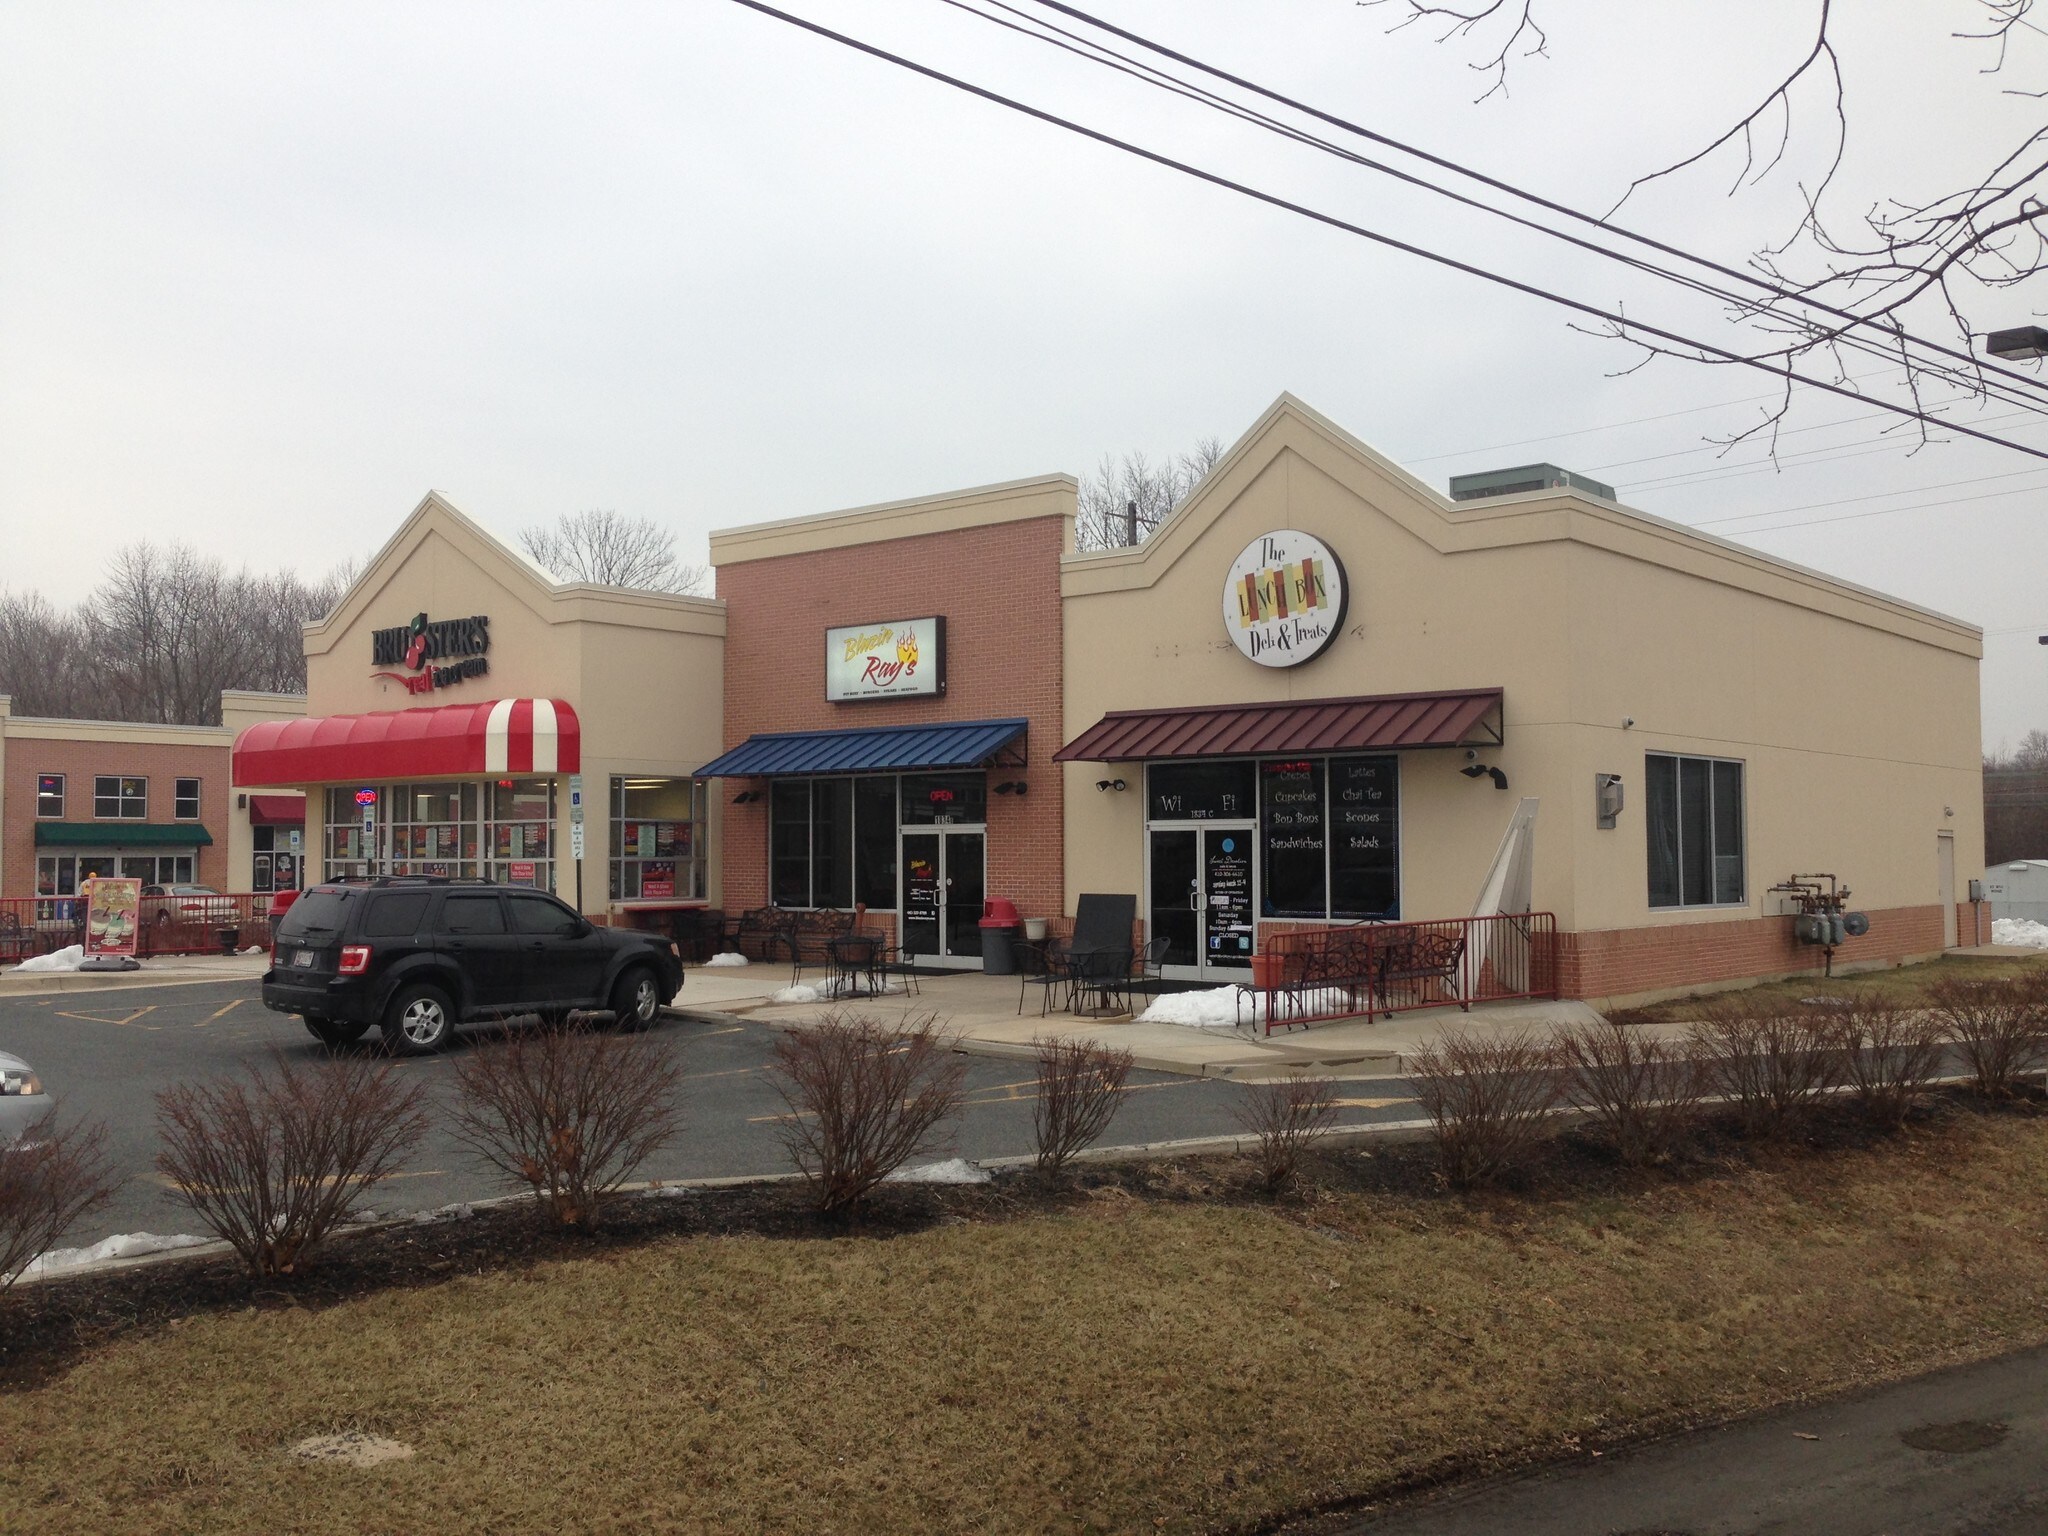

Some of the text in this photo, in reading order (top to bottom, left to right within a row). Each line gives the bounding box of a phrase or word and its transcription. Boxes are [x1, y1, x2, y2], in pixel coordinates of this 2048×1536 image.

[1260, 537, 1286, 567] The
[1250, 617, 1328, 657] Deli & Treats
[355, 791, 377, 803] OPEN
[930, 790, 954, 801] OPEN
[1275, 789, 1318, 803] Cupcakes
[1342, 787, 1383, 801] Chai Tea
[1161, 794, 1236, 811] Wi Fi
[1273, 811, 1319, 824] Bon Bons
[1345, 811, 1380, 823] Scones
[1270, 837, 1323, 849] Sandwiches
[1350, 836, 1379, 848] Salads
